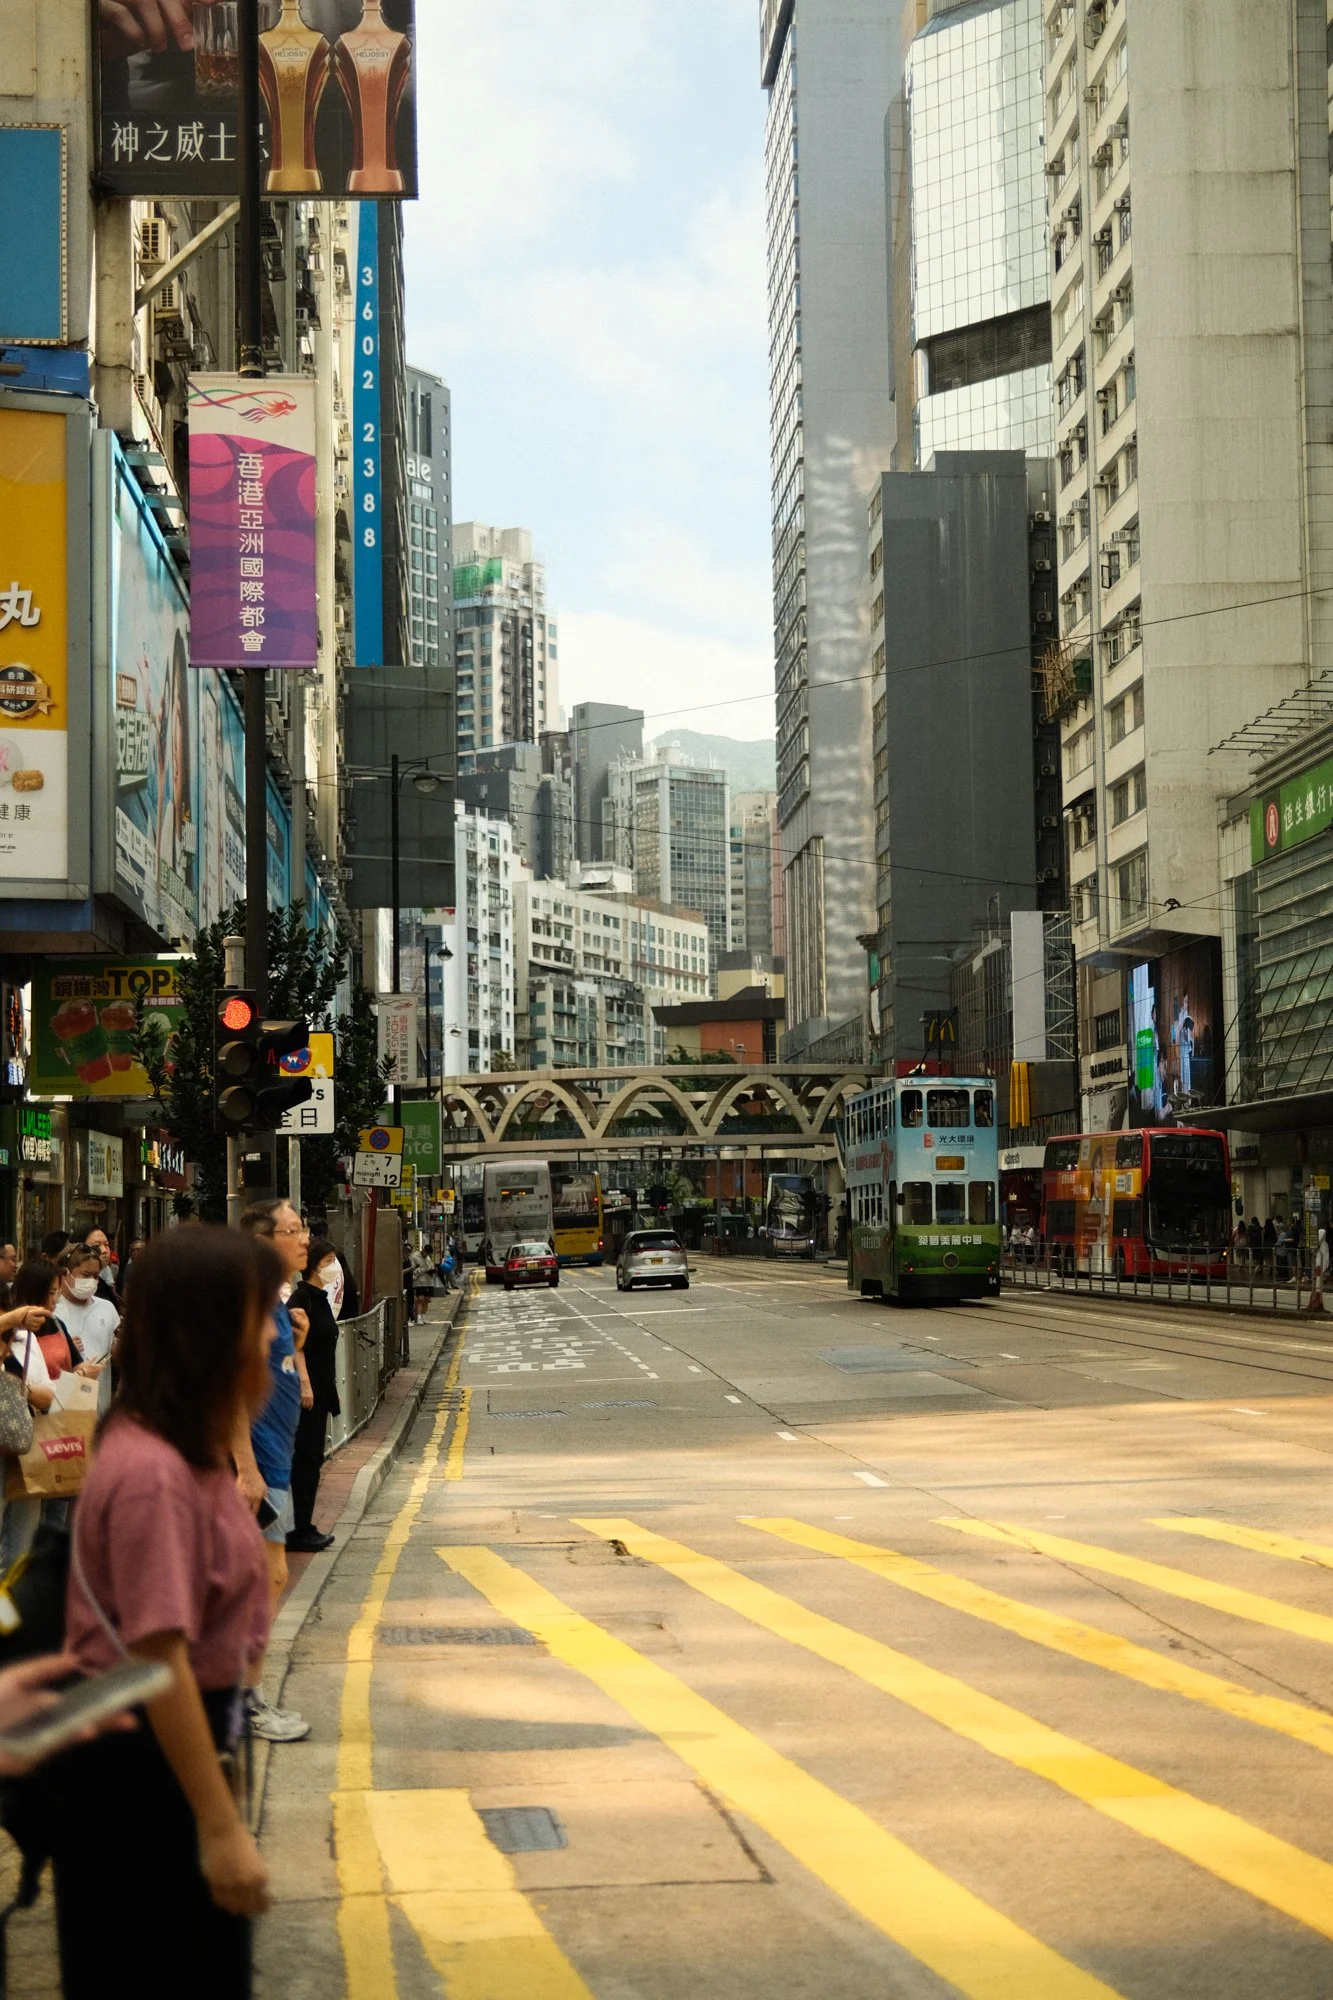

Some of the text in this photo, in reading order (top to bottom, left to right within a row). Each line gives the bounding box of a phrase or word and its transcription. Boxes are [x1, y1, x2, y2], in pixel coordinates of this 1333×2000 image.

[237, 452, 266, 652] 香港亞洲國際都會
[0, 581, 41, 632] 丸
[384, 1156, 393, 1167] 7
[383, 1174, 398, 1186] 12
